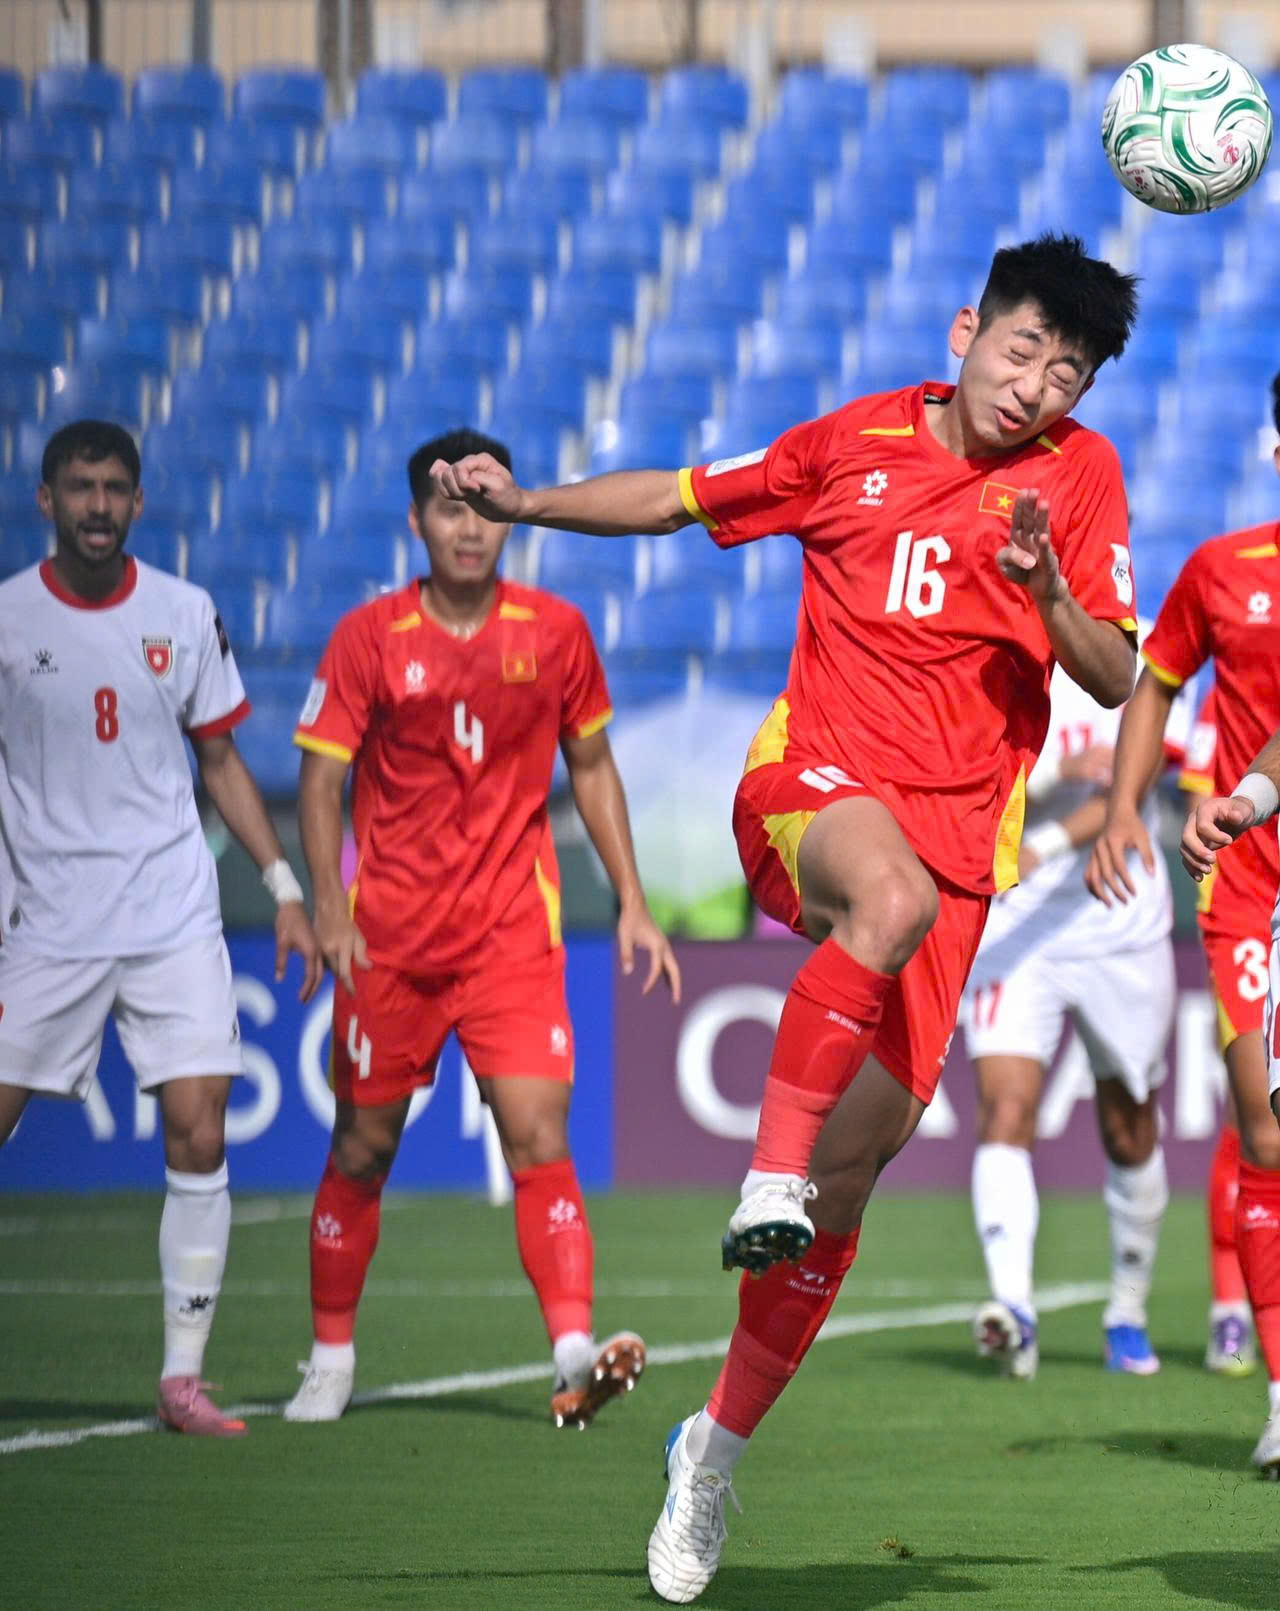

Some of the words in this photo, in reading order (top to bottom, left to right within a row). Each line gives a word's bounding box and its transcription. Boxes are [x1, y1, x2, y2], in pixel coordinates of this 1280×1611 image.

[884, 530, 952, 619] 16
[94, 686, 119, 743] 8
[454, 700, 484, 763] 4
[1233, 938, 1269, 1002] 3
[972, 985, 1003, 1028] 17
[347, 1015, 371, 1079] 4
